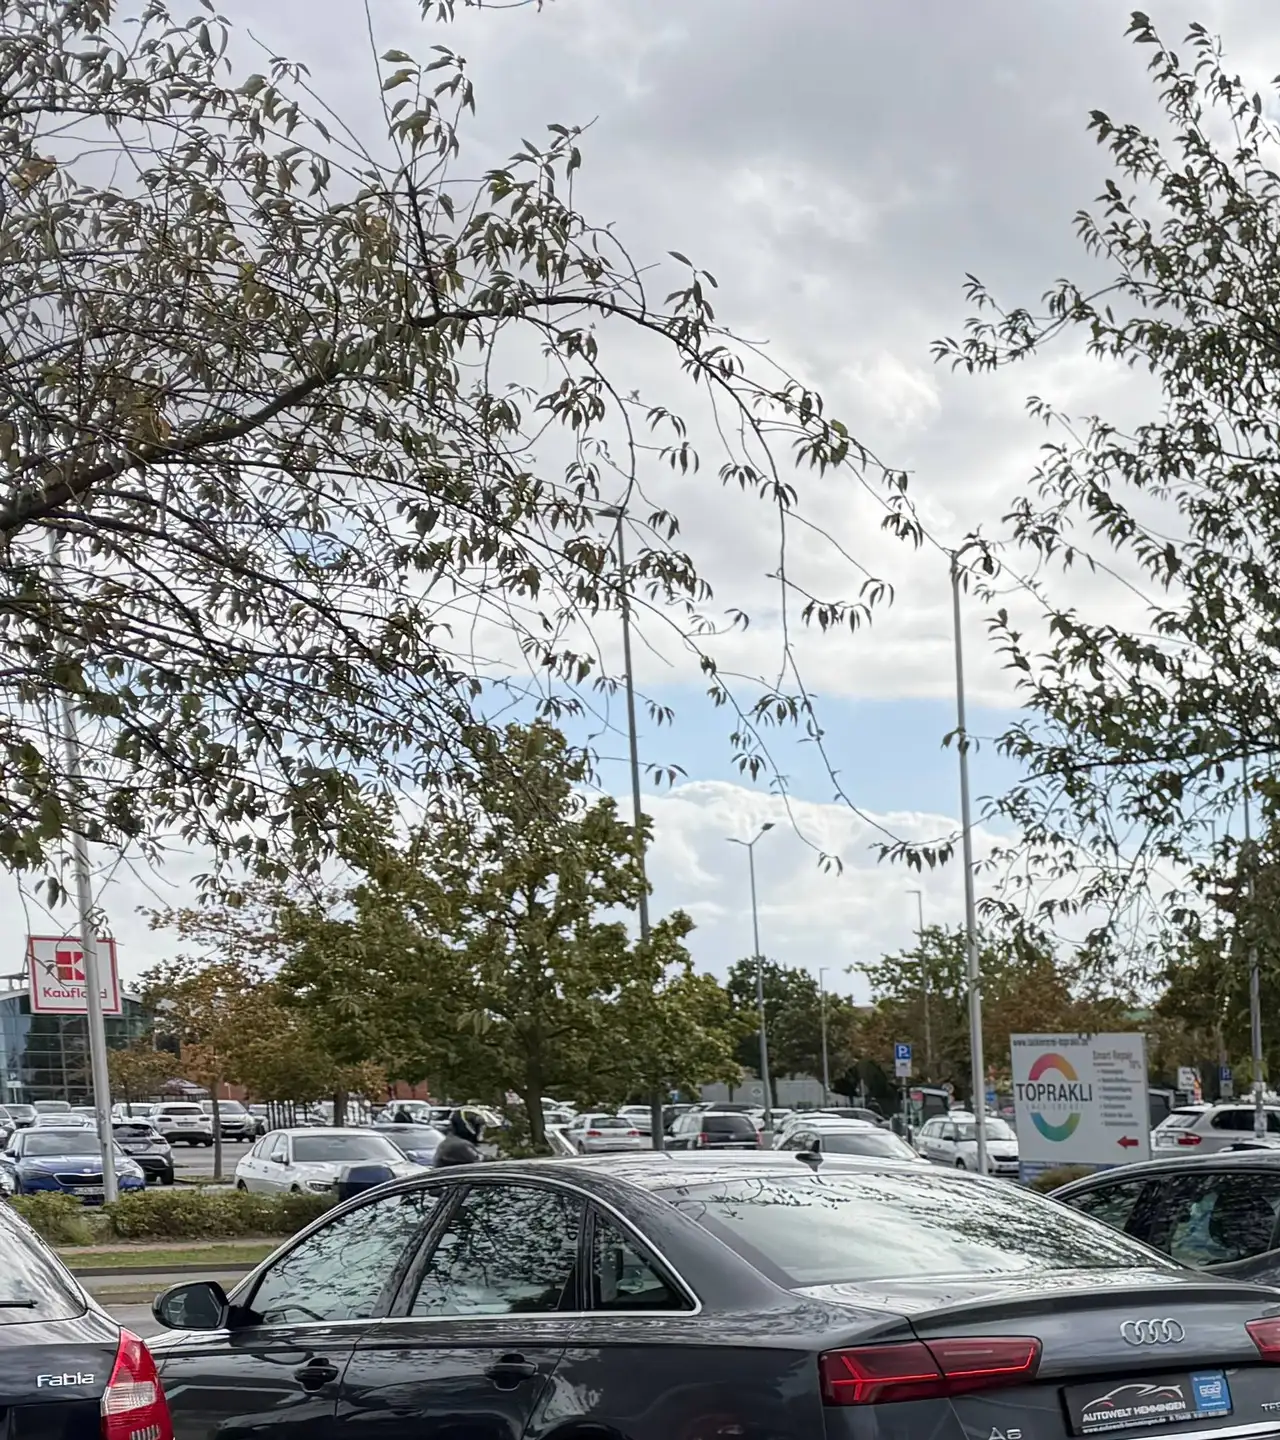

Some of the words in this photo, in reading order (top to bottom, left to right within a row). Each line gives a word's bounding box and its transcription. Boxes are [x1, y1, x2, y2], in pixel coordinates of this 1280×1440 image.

[1016, 1083, 1093, 1101] TOPRAKLI
[37, 1372, 95, 1388] Fabia
[1083, 1407, 1132, 1422] AUTOWELT
[1134, 1401, 1186, 1415] HEMMINGEN
